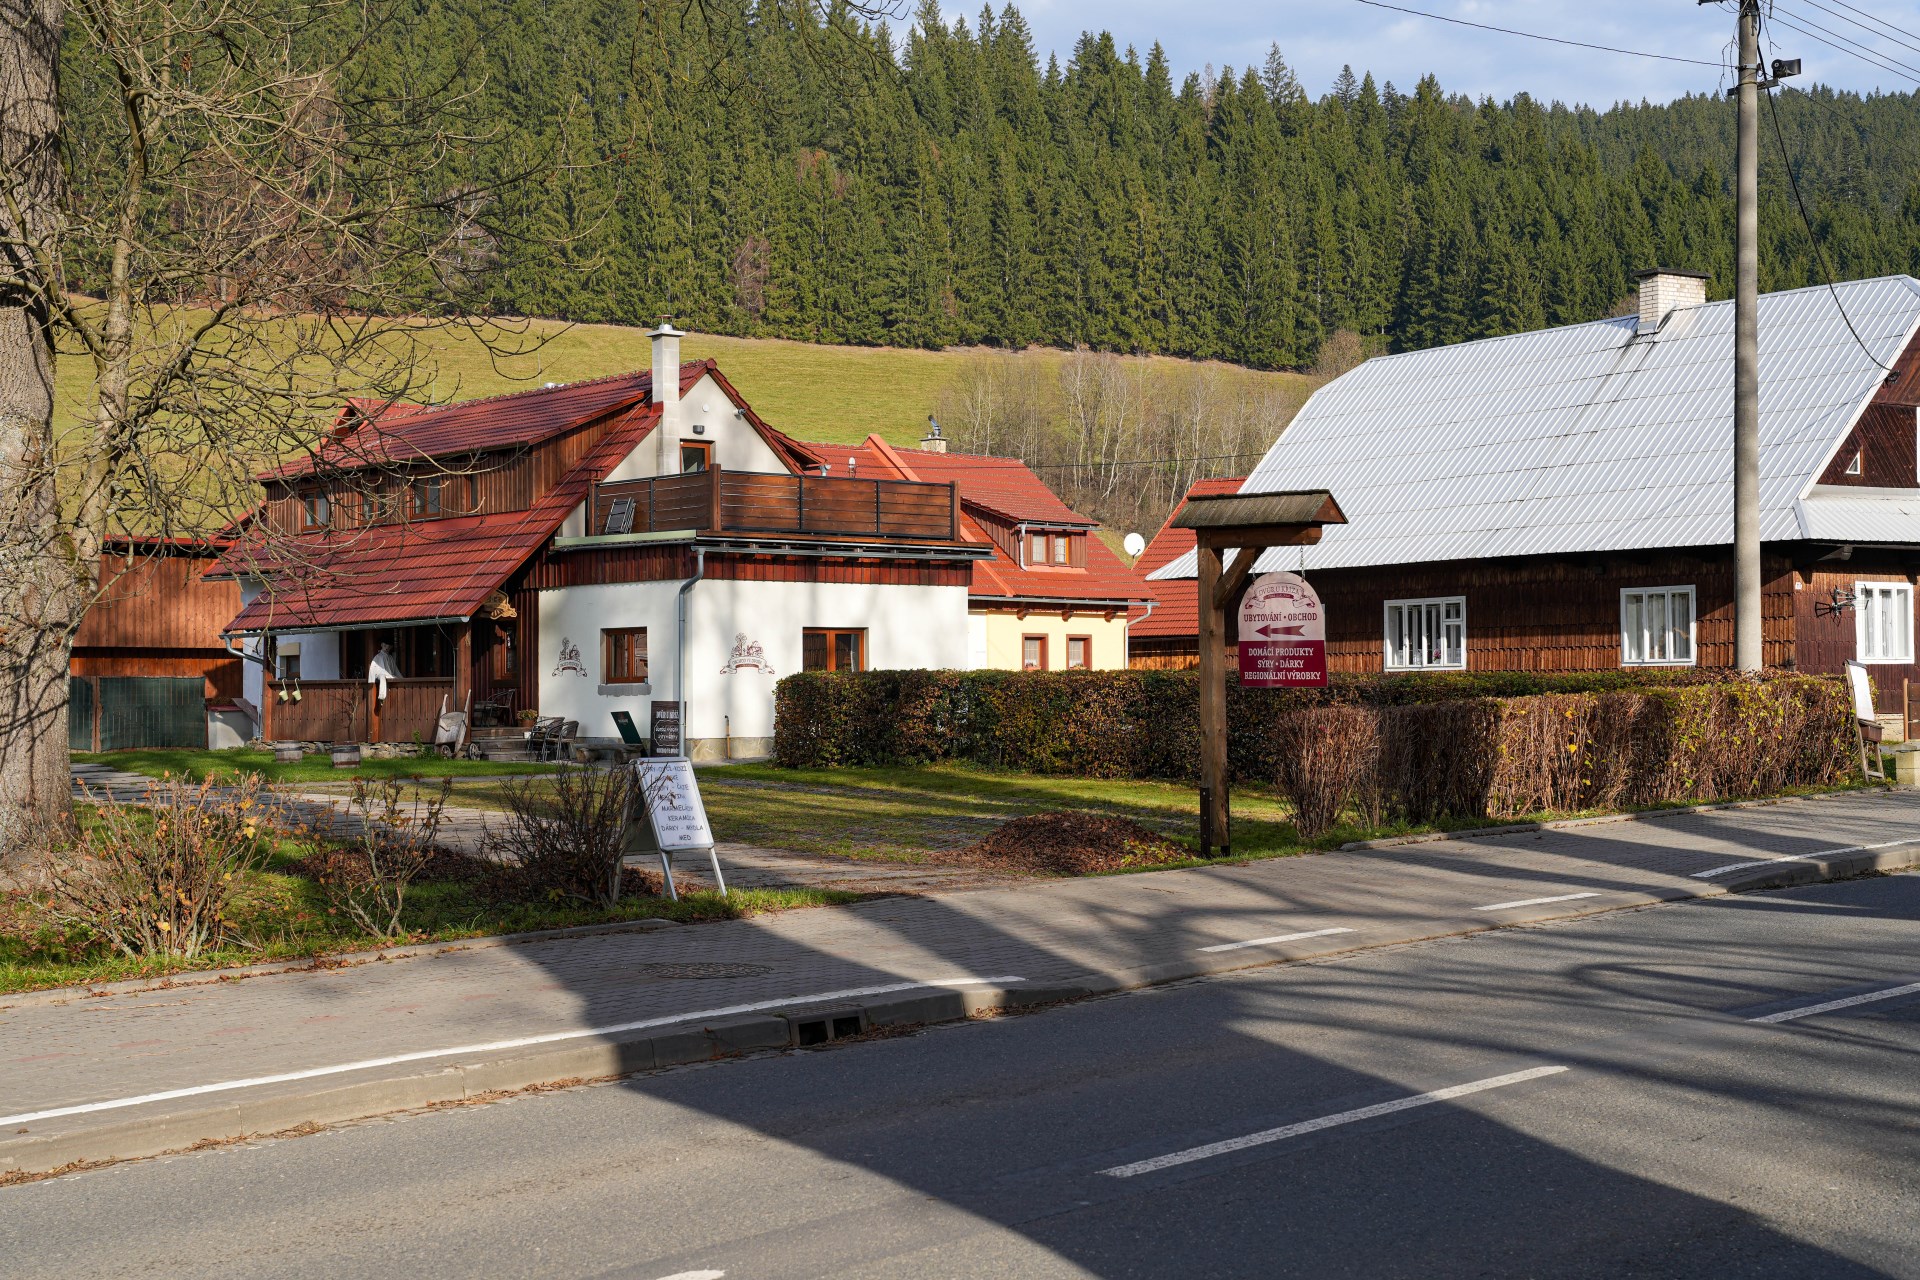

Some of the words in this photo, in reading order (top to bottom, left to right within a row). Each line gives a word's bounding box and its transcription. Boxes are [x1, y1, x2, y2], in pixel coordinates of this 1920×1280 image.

[1243, 612, 1282, 622] UBYTOVÁNÍ
[1287, 612, 1318, 621] OBCHOD
[1248, 646, 1274, 656] DOMÁCÍ
[1275, 647, 1314, 656] PRODUKTY
[1257, 658, 1274, 668] SÝRY
[1280, 658, 1304, 668] DÁRKY
[1244, 670, 1286, 680] REGIONÁLNÍ
[1286, 670, 1321, 680] VÝROBKY
